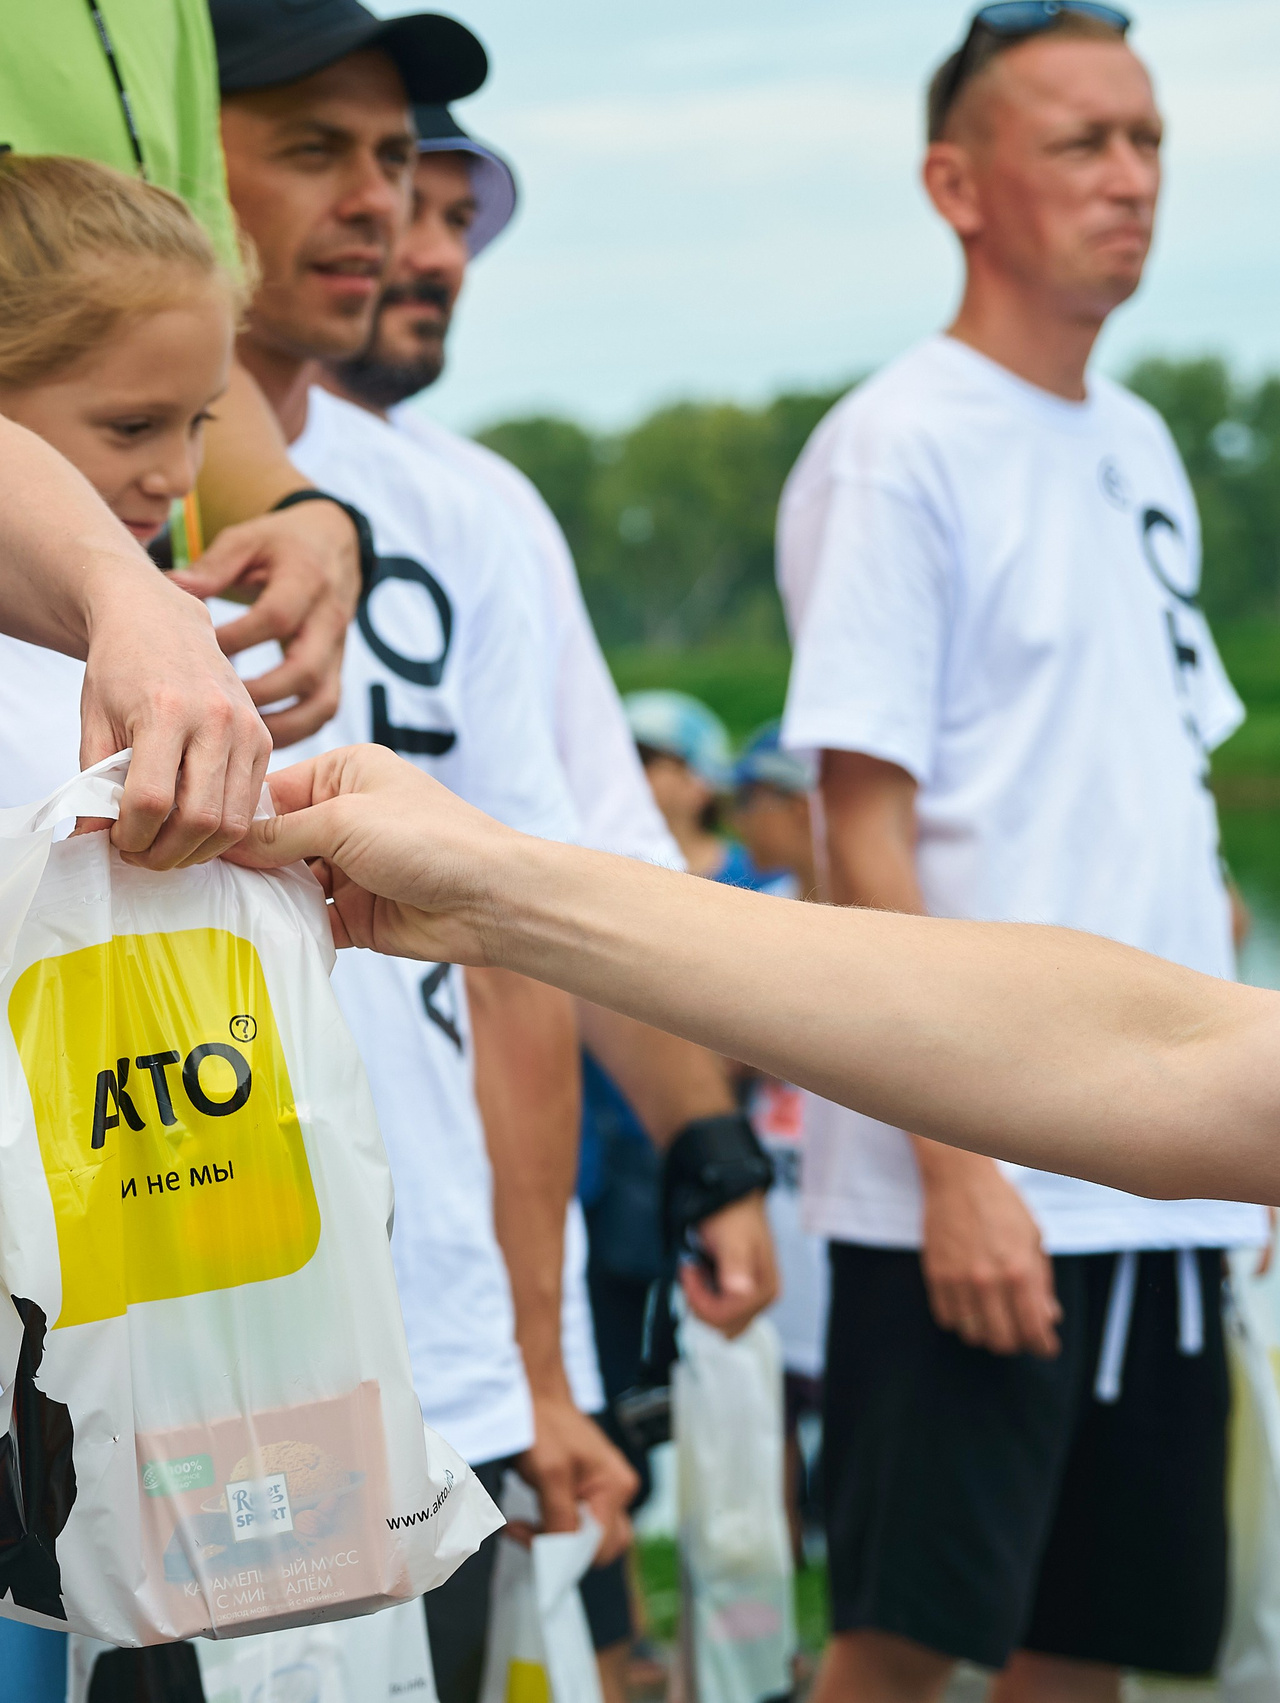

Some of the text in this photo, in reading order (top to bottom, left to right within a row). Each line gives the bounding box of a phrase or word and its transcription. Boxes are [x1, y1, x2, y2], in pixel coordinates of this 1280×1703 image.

[91, 1042, 252, 1149] АКТО
[121, 1160, 234, 1199] и не мы
[236, 1506, 287, 1528] SPRT
[311, 1550, 360, 1573] МУСС
